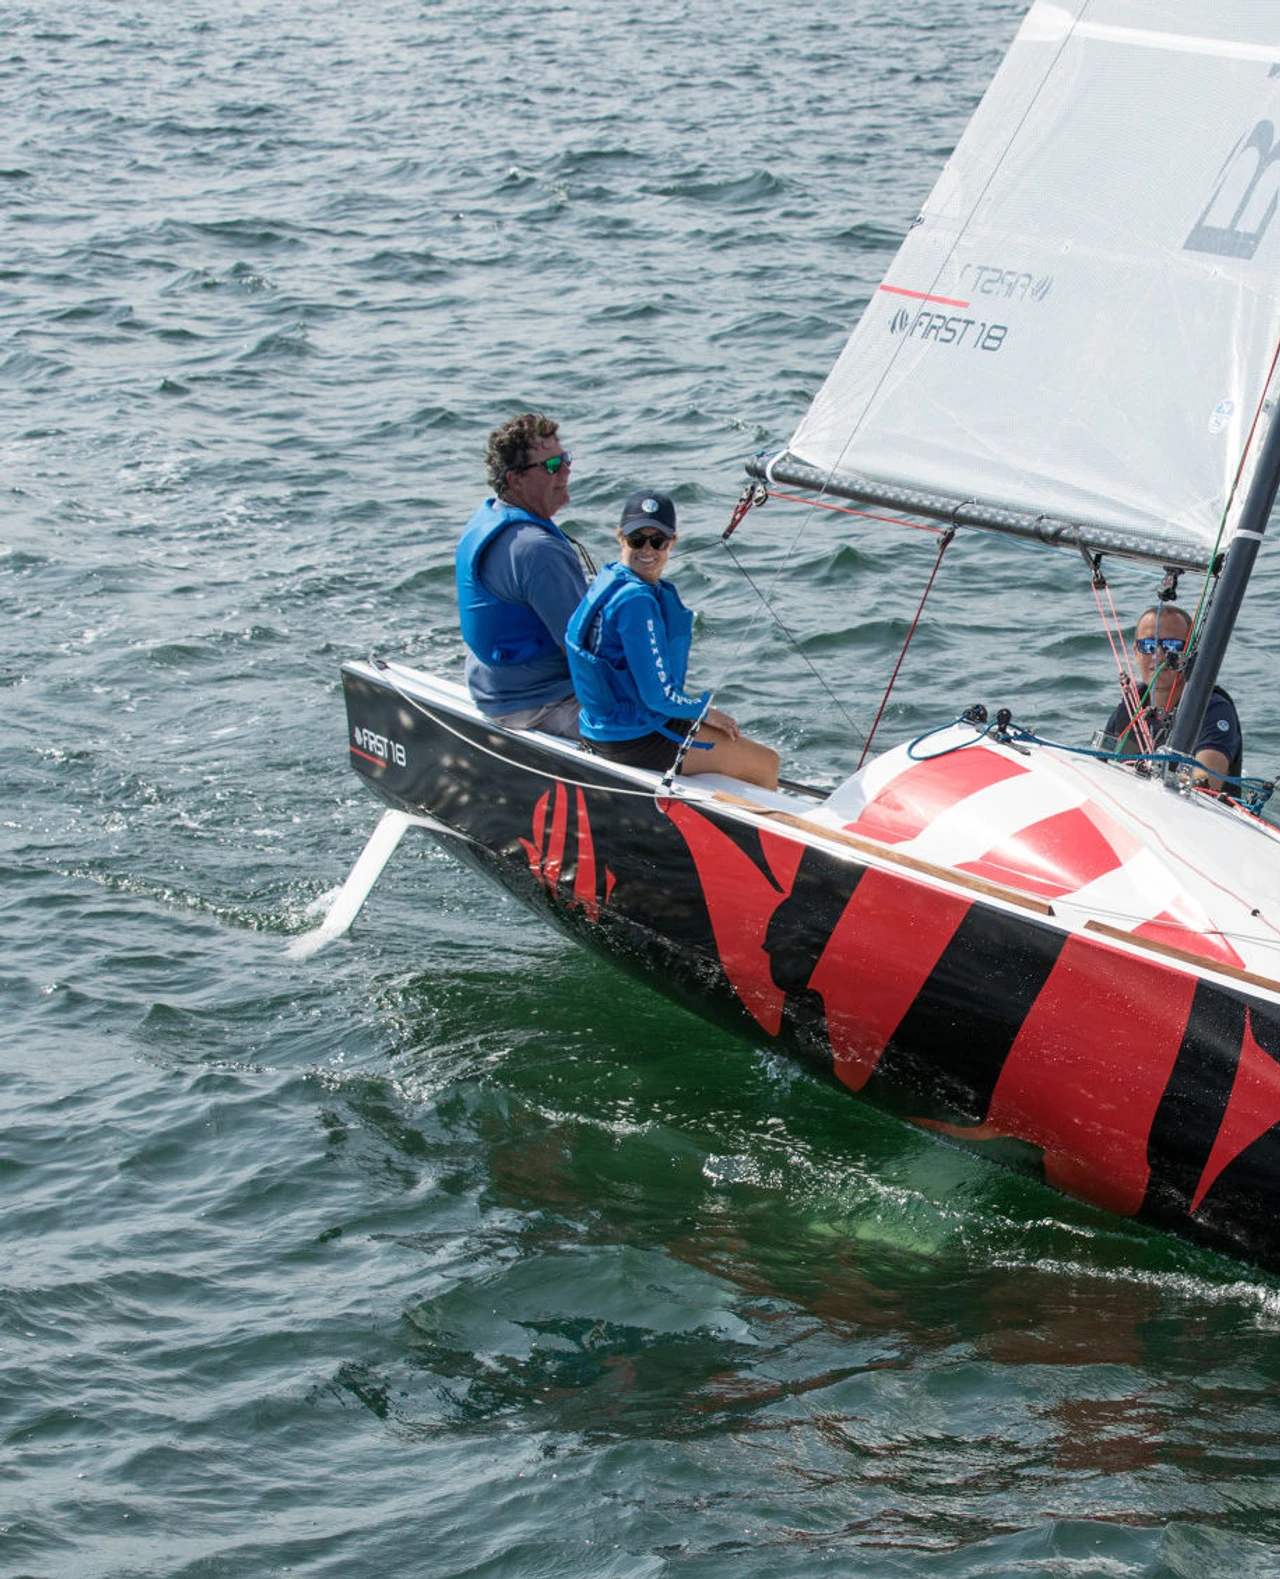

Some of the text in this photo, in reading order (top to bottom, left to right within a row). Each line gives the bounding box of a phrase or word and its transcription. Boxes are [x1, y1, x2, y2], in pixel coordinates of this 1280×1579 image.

[909, 312, 1008, 352] FIRST 18
[362, 727, 406, 767] FIRST 18
